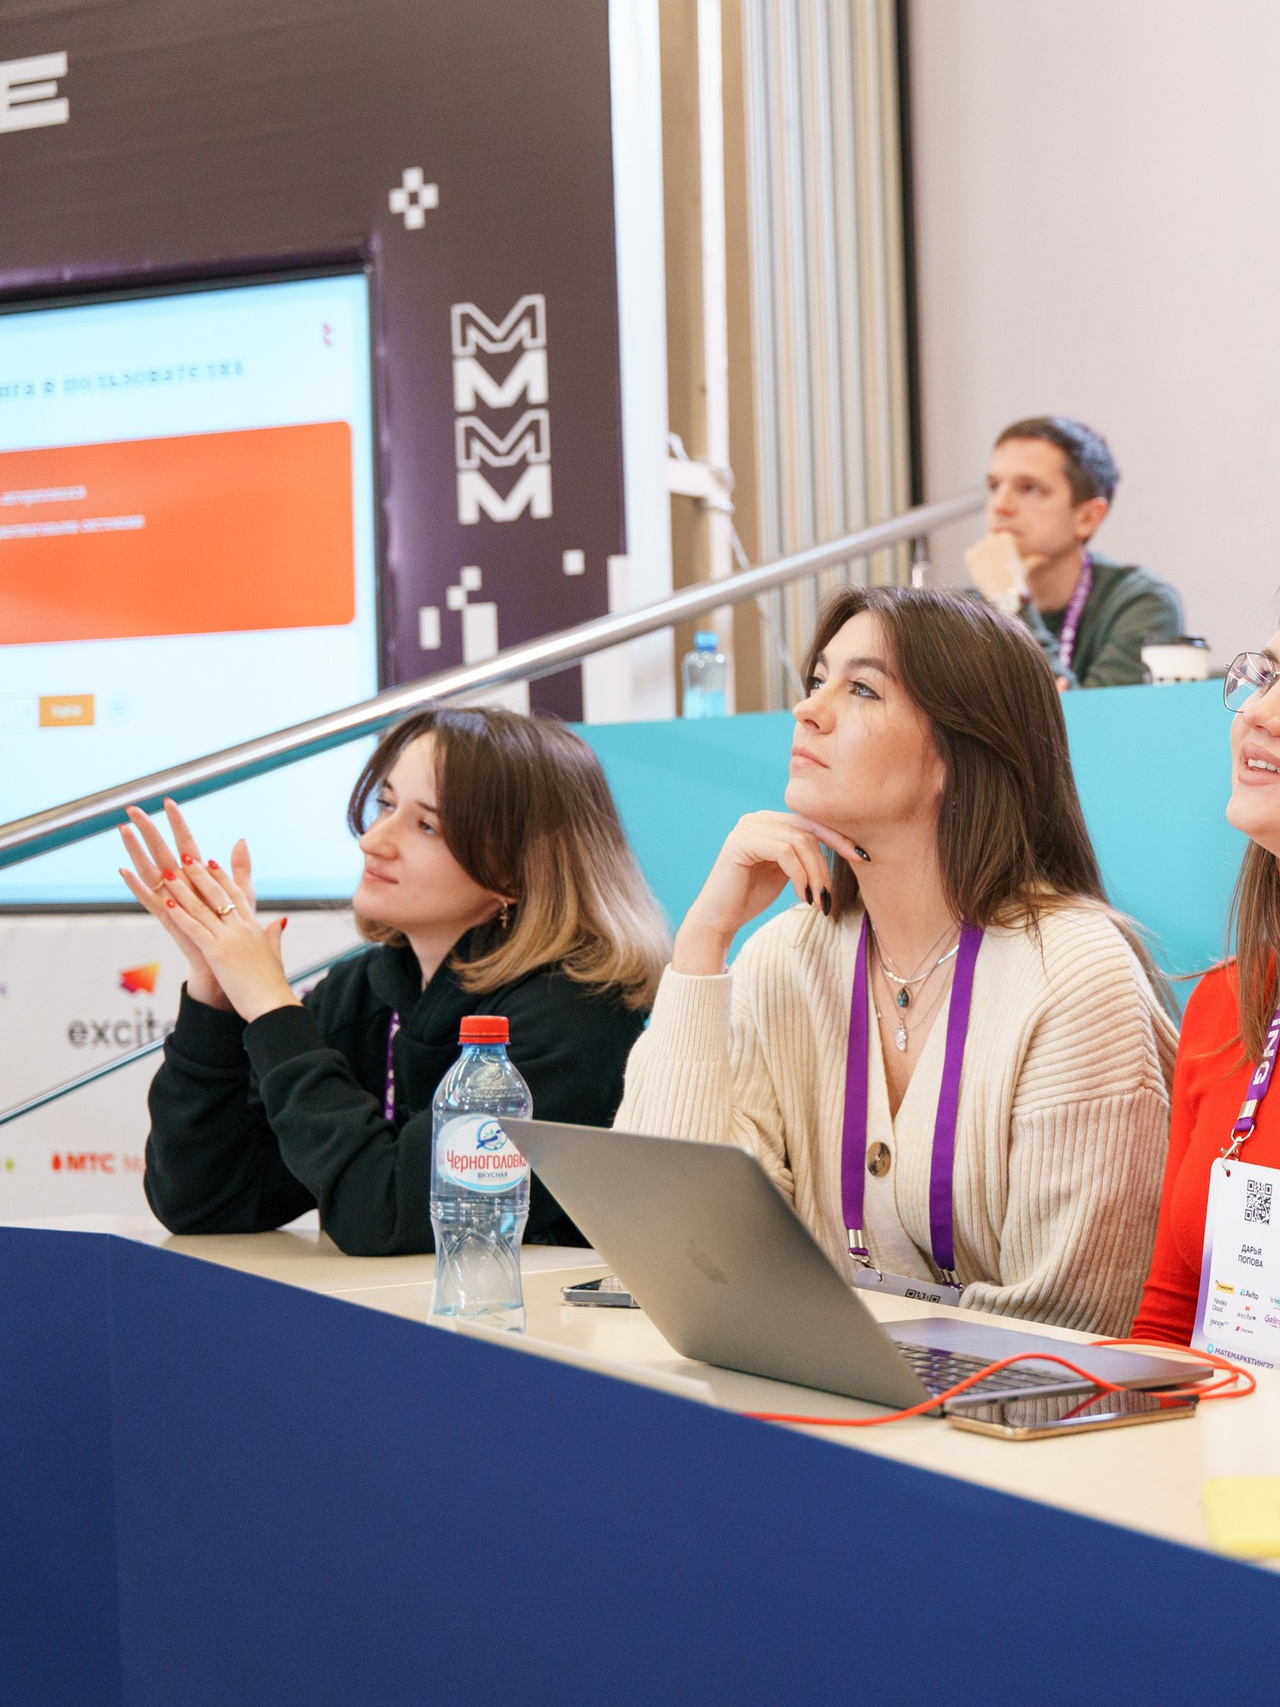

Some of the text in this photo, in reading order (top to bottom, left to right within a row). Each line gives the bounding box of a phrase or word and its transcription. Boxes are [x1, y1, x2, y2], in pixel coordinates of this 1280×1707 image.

[477, 1171, 508, 1179] ВКУСНАЯ
[1241, 1244, 1262, 1256] ДАРЬЯ
[1238, 1254, 1263, 1268] ПОПОВА
